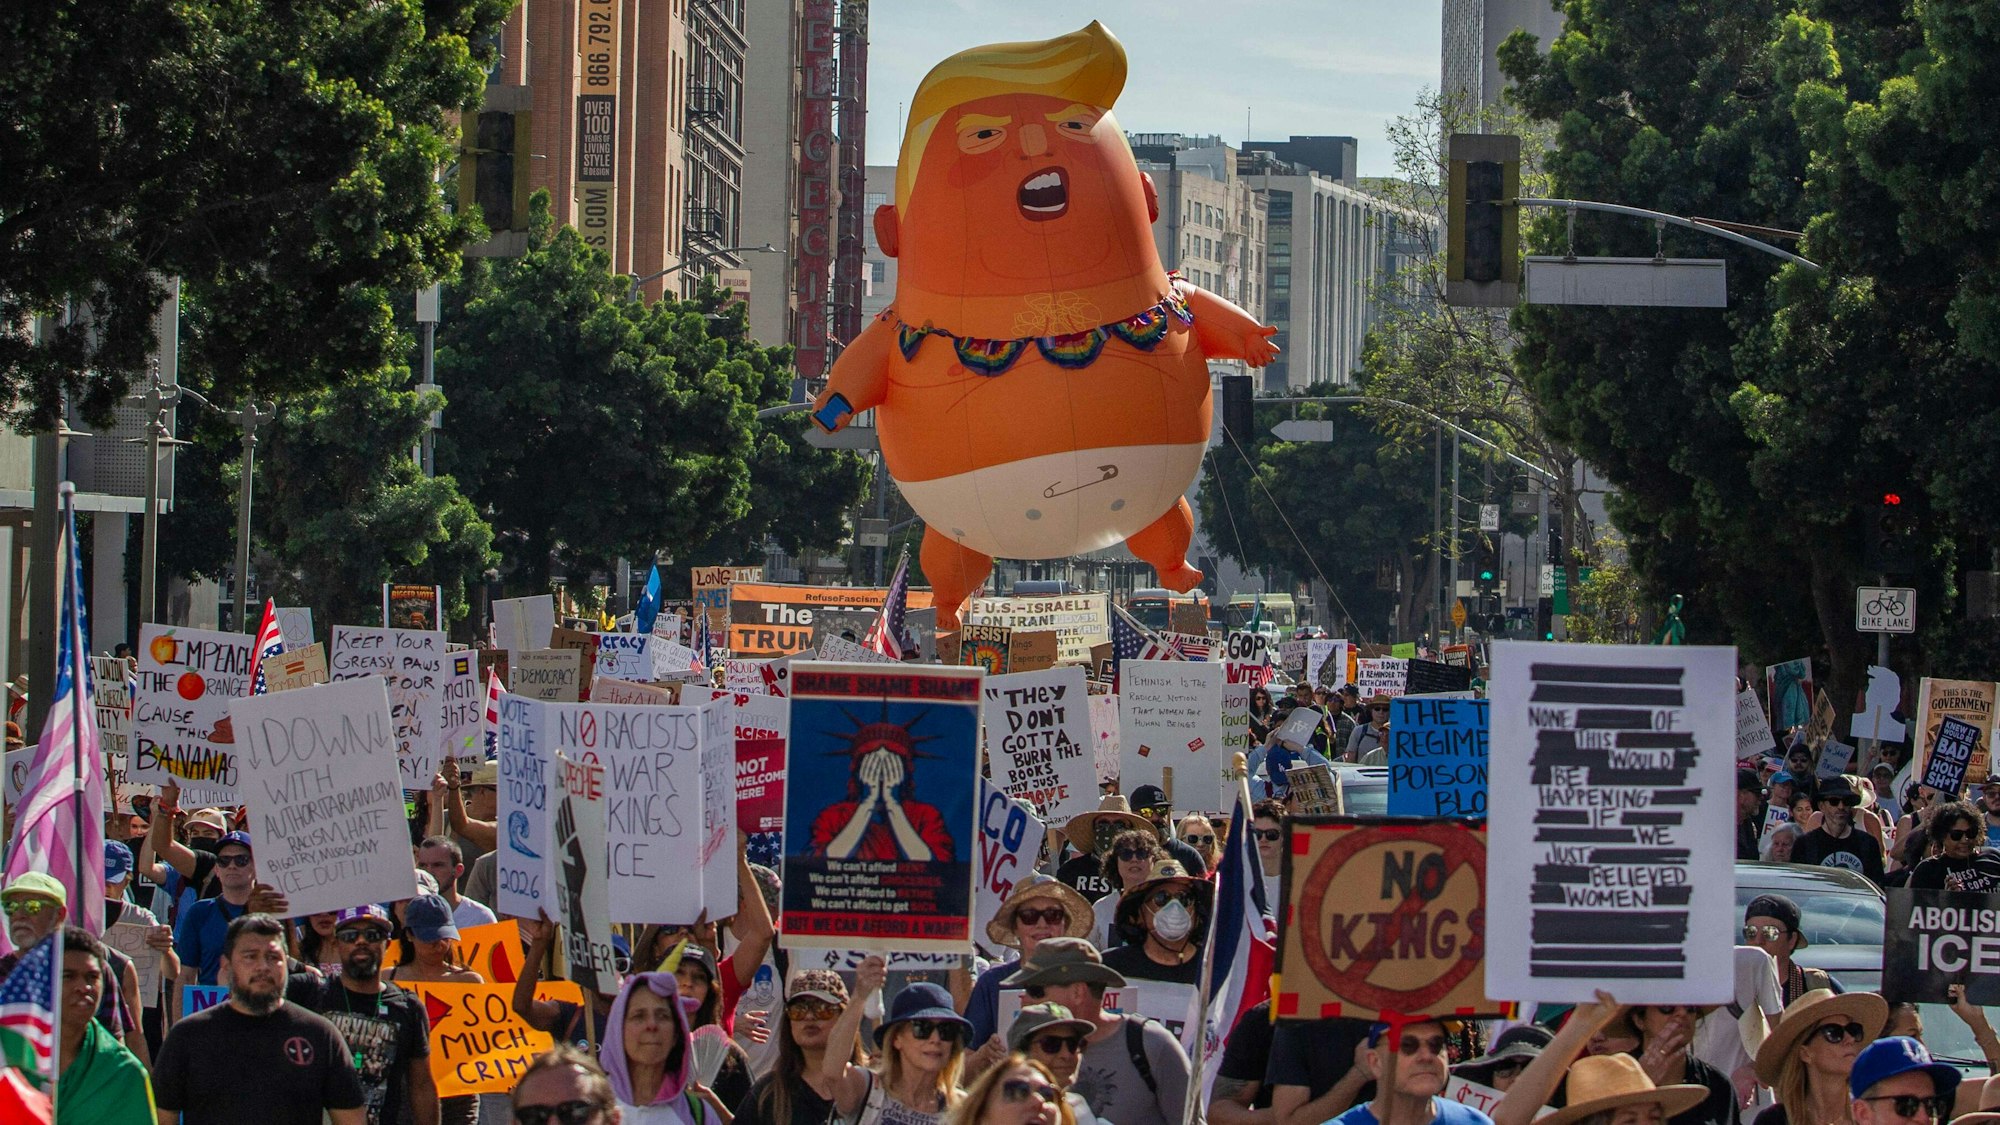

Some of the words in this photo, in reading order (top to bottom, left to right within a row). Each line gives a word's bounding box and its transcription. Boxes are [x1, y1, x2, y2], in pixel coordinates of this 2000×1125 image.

[584, 101, 611, 115] OVER
[584, 115, 611, 134] 100
[584, 134, 602, 143] YEARS
[603, 134, 610, 143] OF
[584, 143, 611, 154] LIVING
[583, 153, 610, 167] STYLE
[589, 167, 610, 176] DESIGN
[800, 129, 829, 350] CECIL
[391, 591, 416, 600] BIGGER
[416, 591, 435, 599] VOTE
[761, 603, 813, 625] The
[986, 600, 1090, 614] U.S.-ISRAELI
[981, 616, 1003, 626] ON
[1009, 615, 1055, 626] IRAN!
[1862, 617, 1882, 627] BIKE
[1887, 617, 1909, 628] LANE
[336, 630, 384, 650] KEEP
[395, 632, 434, 651] YOUR
[962, 625, 1011, 643] RESIST
[1011, 639, 1033, 649] Kings
[1228, 632, 1267, 661] GOP
[164, 639, 253, 676] IMPEACH
[269, 647, 318, 668] SILENCE
[333, 651, 394, 670] GREASY
[403, 656, 440, 672] PAWS
[137, 670, 175, 693] THE
[206, 677, 249, 697] RANGE
[401, 676, 434, 690] OUR
[521, 667, 577, 686] DEMOCRACY
[796, 674, 850, 694] SHAME
[857, 677, 912, 697] SHAME
[919, 679, 974, 699] SHAME
[1129, 665, 1172, 688] FEMINISM
[1180, 677, 1189, 688] IS
[1943, 689, 1960, 698] THIS
[1961, 688, 1968, 697] IS
[1969, 690, 1983, 699] THE
[500, 698, 531, 726] VOTE
[1397, 701, 1459, 726] THE
[1932, 699, 1992, 713] GOVERNMENT
[1005, 704, 1066, 734] DON'T
[1528, 707, 1572, 728] NONE
[1655, 710, 1680, 731] OF
[1946, 721, 1968, 734] KNEW
[1968, 729, 1976, 737] IT
[175, 727, 208, 739] THIS
[262, 714, 372, 767] DOWN
[502, 724, 536, 756] BLUE
[604, 711, 698, 751] RACISTS
[1002, 729, 1071, 754] GOTTA
[1574, 729, 1612, 748] THIS
[1944, 729, 1965, 741] WOULD
[1013, 748, 1052, 768] BURN
[1056, 743, 1082, 760] THE
[1609, 749, 1671, 770] WOULD
[1937, 737, 1969, 761] BAD
[1971, 754, 1985, 764] OUT
[137, 738, 238, 787] BANANAS
[514, 756, 548, 785] WHAT
[611, 752, 677, 794] WAR
[736, 757, 768, 775] NOT
[1008, 762, 1053, 783] BOOKS
[1931, 759, 1962, 778] HOLY
[263, 764, 334, 805] WITH
[1003, 780, 1028, 795] THEY
[1033, 774, 1060, 788] JUST
[1551, 767, 1586, 787] BE
[506, 778, 523, 804] TO
[1539, 786, 1648, 809] HAPPENING
[265, 781, 397, 844] AUTHORITARIANISM
[609, 795, 682, 837] KINGS
[1592, 808, 1616, 830] IF
[346, 808, 388, 840] HATE
[1636, 825, 1675, 845] WE
[606, 841, 655, 879] ICE
[1546, 842, 1588, 866] JUST
[827, 860, 845, 872] We
[845, 861, 867, 872] can't
[868, 861, 897, 873] afford
[1381, 851, 1448, 900] NO
[1589, 866, 1686, 887] BELIEVED
[276, 870, 314, 894] ICE
[500, 867, 540, 899] 2026
[809, 872, 826, 884] We
[826, 874, 850, 884] can't
[850, 874, 880, 885] afford
[1969, 876, 1991, 890] COPS
[815, 885, 831, 897] We
[831, 887, 855, 897] can't
[856, 886, 885, 898] afford
[886, 887, 896, 898] to
[1564, 886, 1649, 908] WOMEN
[811, 898, 828, 910] We
[828, 899, 852, 909] can't
[852, 899, 881, 911] afford
[882, 900, 892, 911] to
[893, 901, 909, 913] get
[786, 916, 809, 930] BUT
[813, 917, 831, 931] WE
[835, 918, 859, 932] CAN
[863, 918, 907, 934] AFFORD
[912, 920, 920, 934] A
[1330, 907, 1486, 961] KINGS
[1918, 934, 2000, 974] ICE
[463, 993, 513, 1027] SO.
[440, 1026, 536, 1060] MUCH.
[457, 1052, 542, 1084] CRIM
